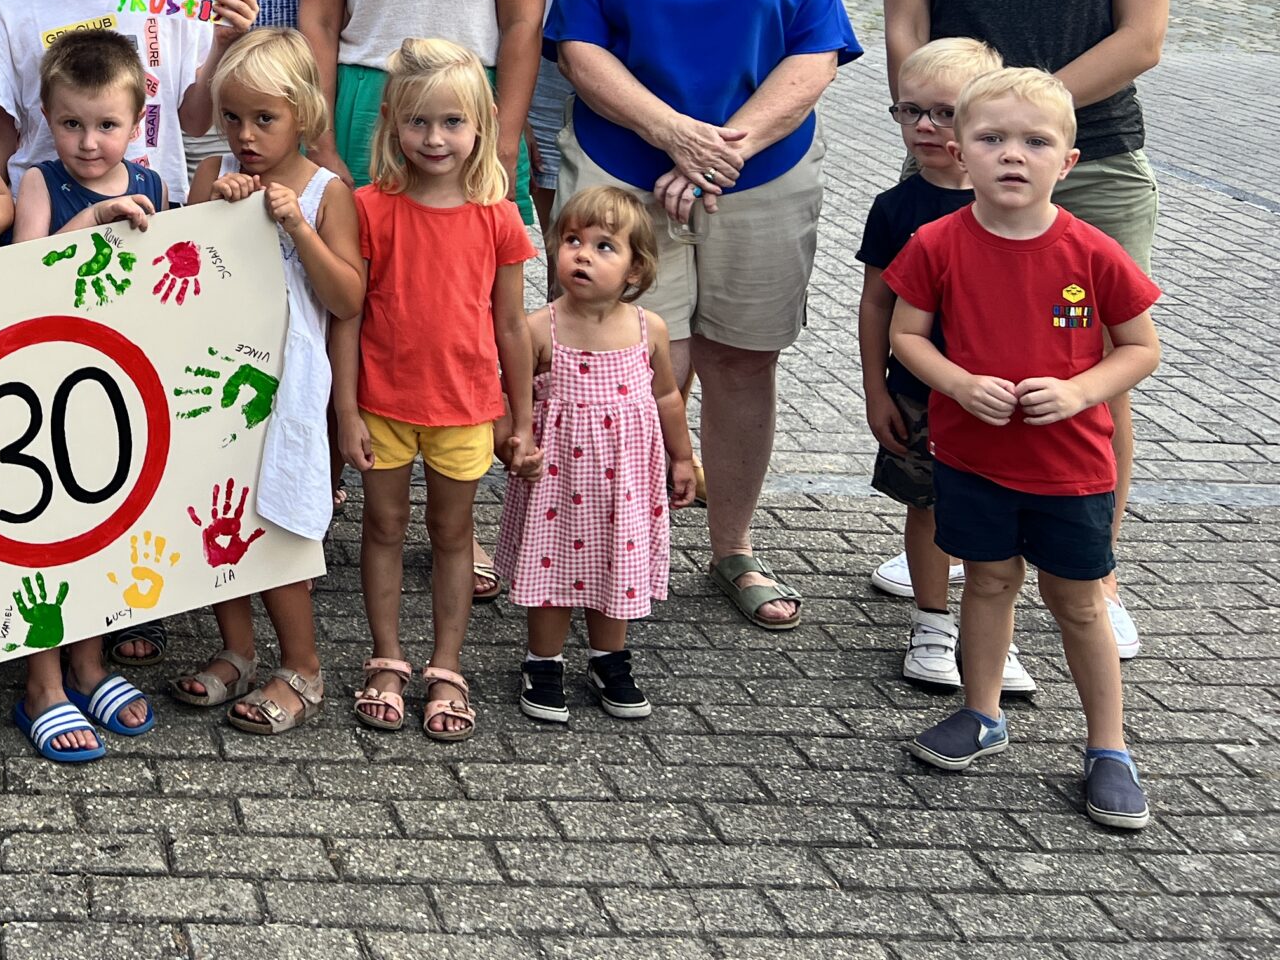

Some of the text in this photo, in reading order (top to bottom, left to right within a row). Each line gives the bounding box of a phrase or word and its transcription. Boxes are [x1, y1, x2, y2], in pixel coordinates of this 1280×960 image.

[147, 17, 159, 68] FUTURE
[147, 105, 158, 146] AGAIN
[103, 227, 124, 249] RUNE
[205, 246, 232, 280] SUSAN
[235, 344, 271, 363] VINCE
[214, 568, 236, 588] LIA
[105, 607, 132, 628] LUCY
